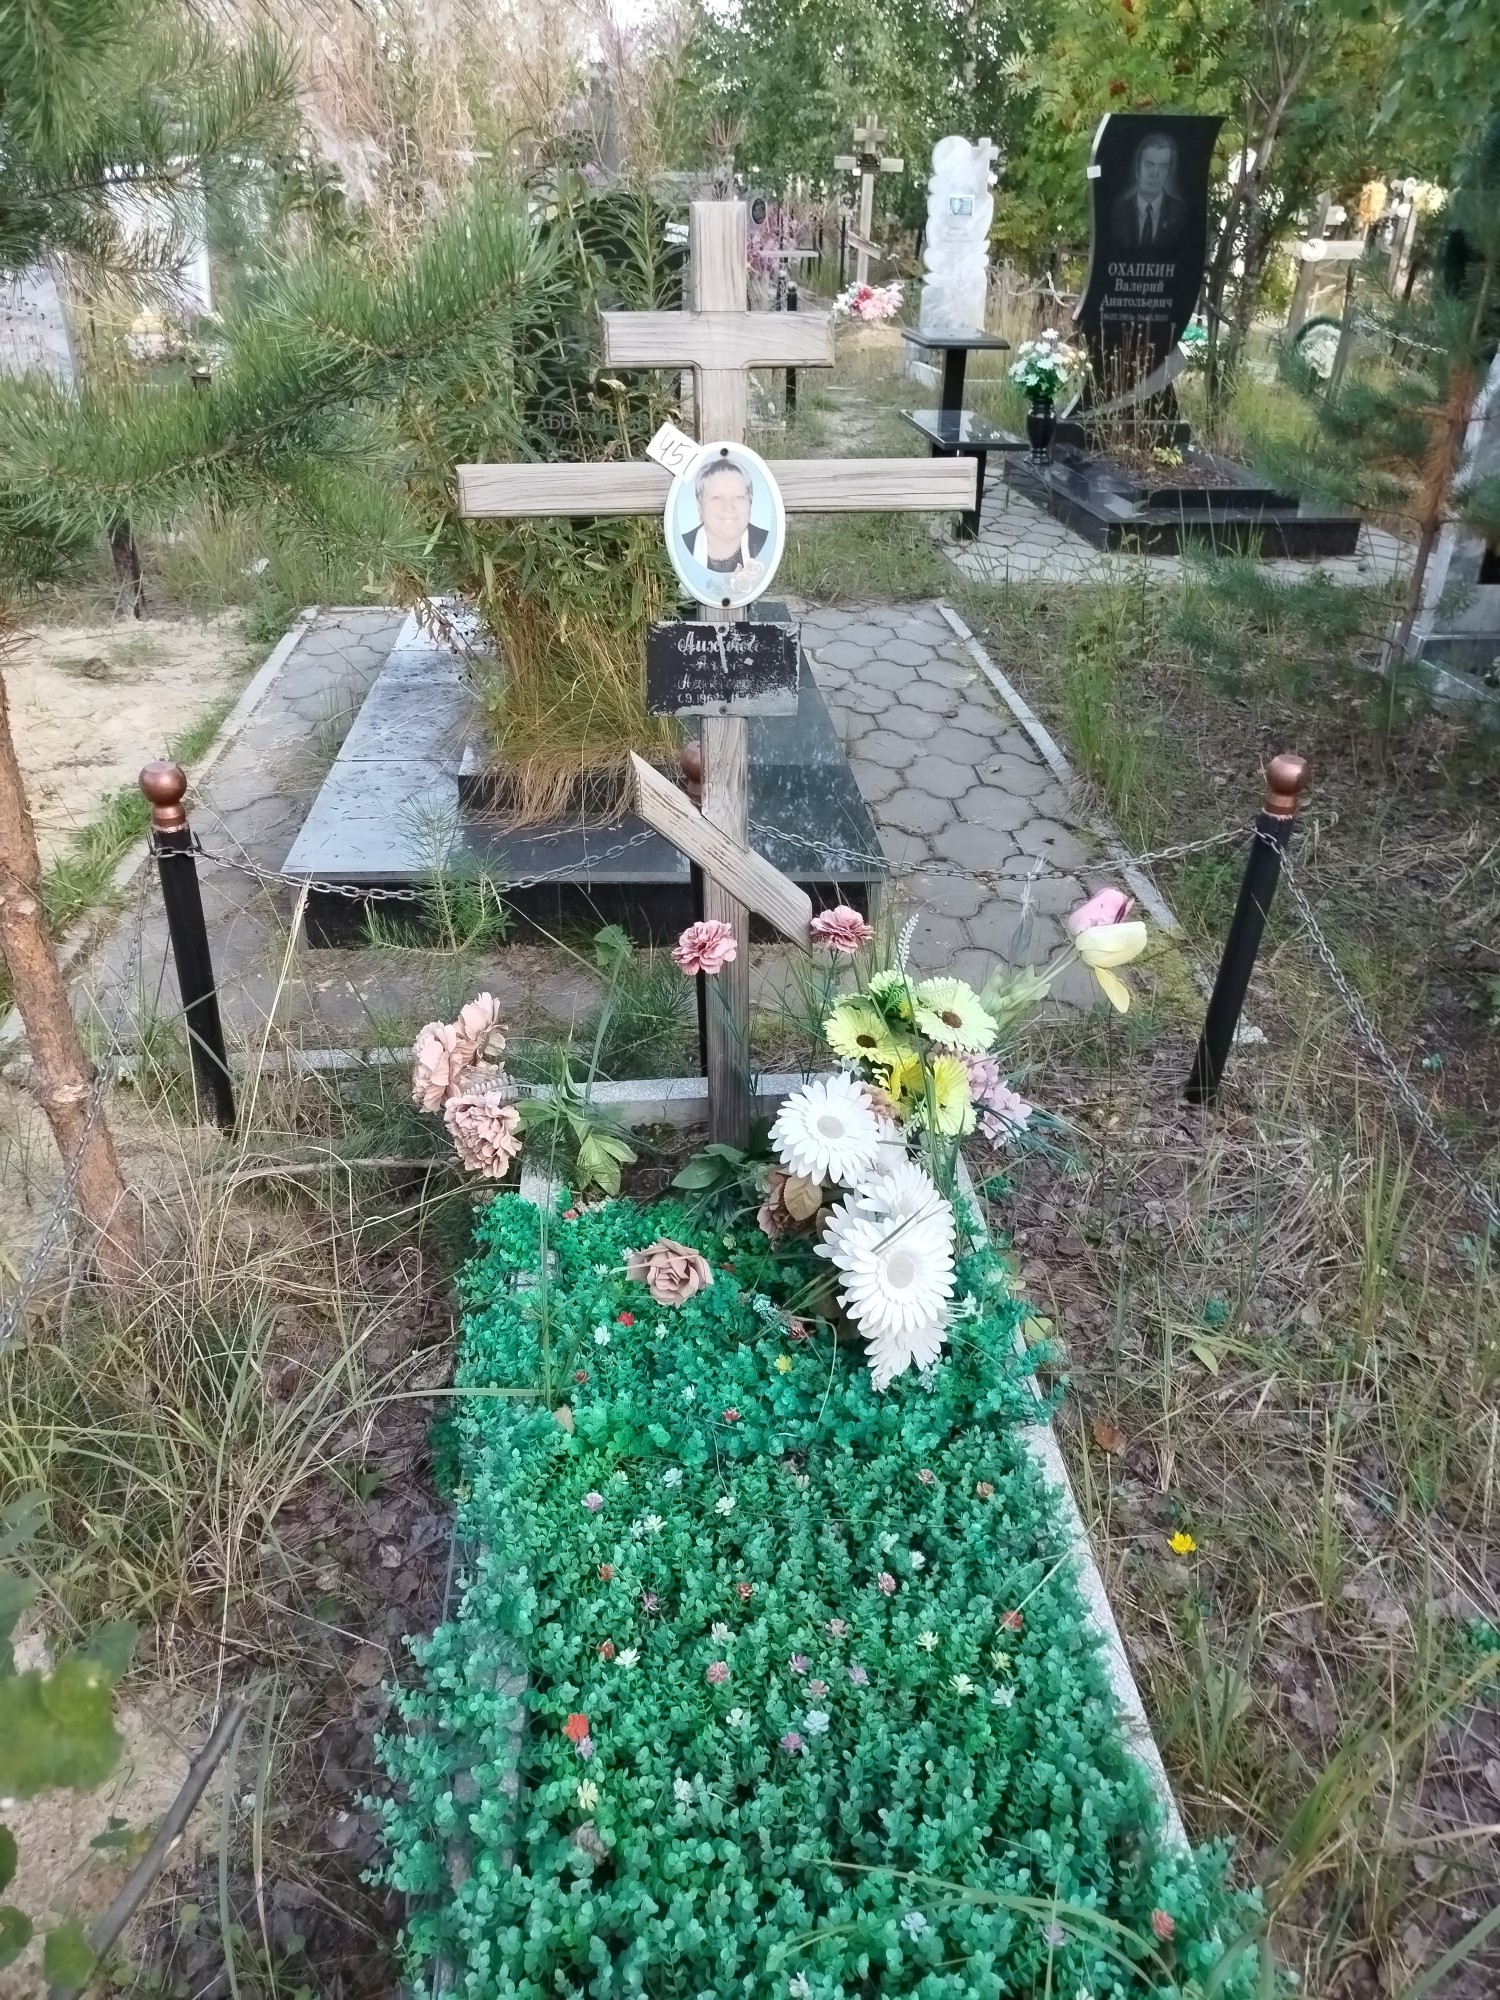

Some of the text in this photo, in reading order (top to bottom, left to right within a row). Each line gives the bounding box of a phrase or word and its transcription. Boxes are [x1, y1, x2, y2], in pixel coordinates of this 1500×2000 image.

[1108, 262, 1176, 277] ОХАПКИН
[1114, 278, 1164, 295] Валерий
[1102, 294, 1173, 308] Анатольевич
